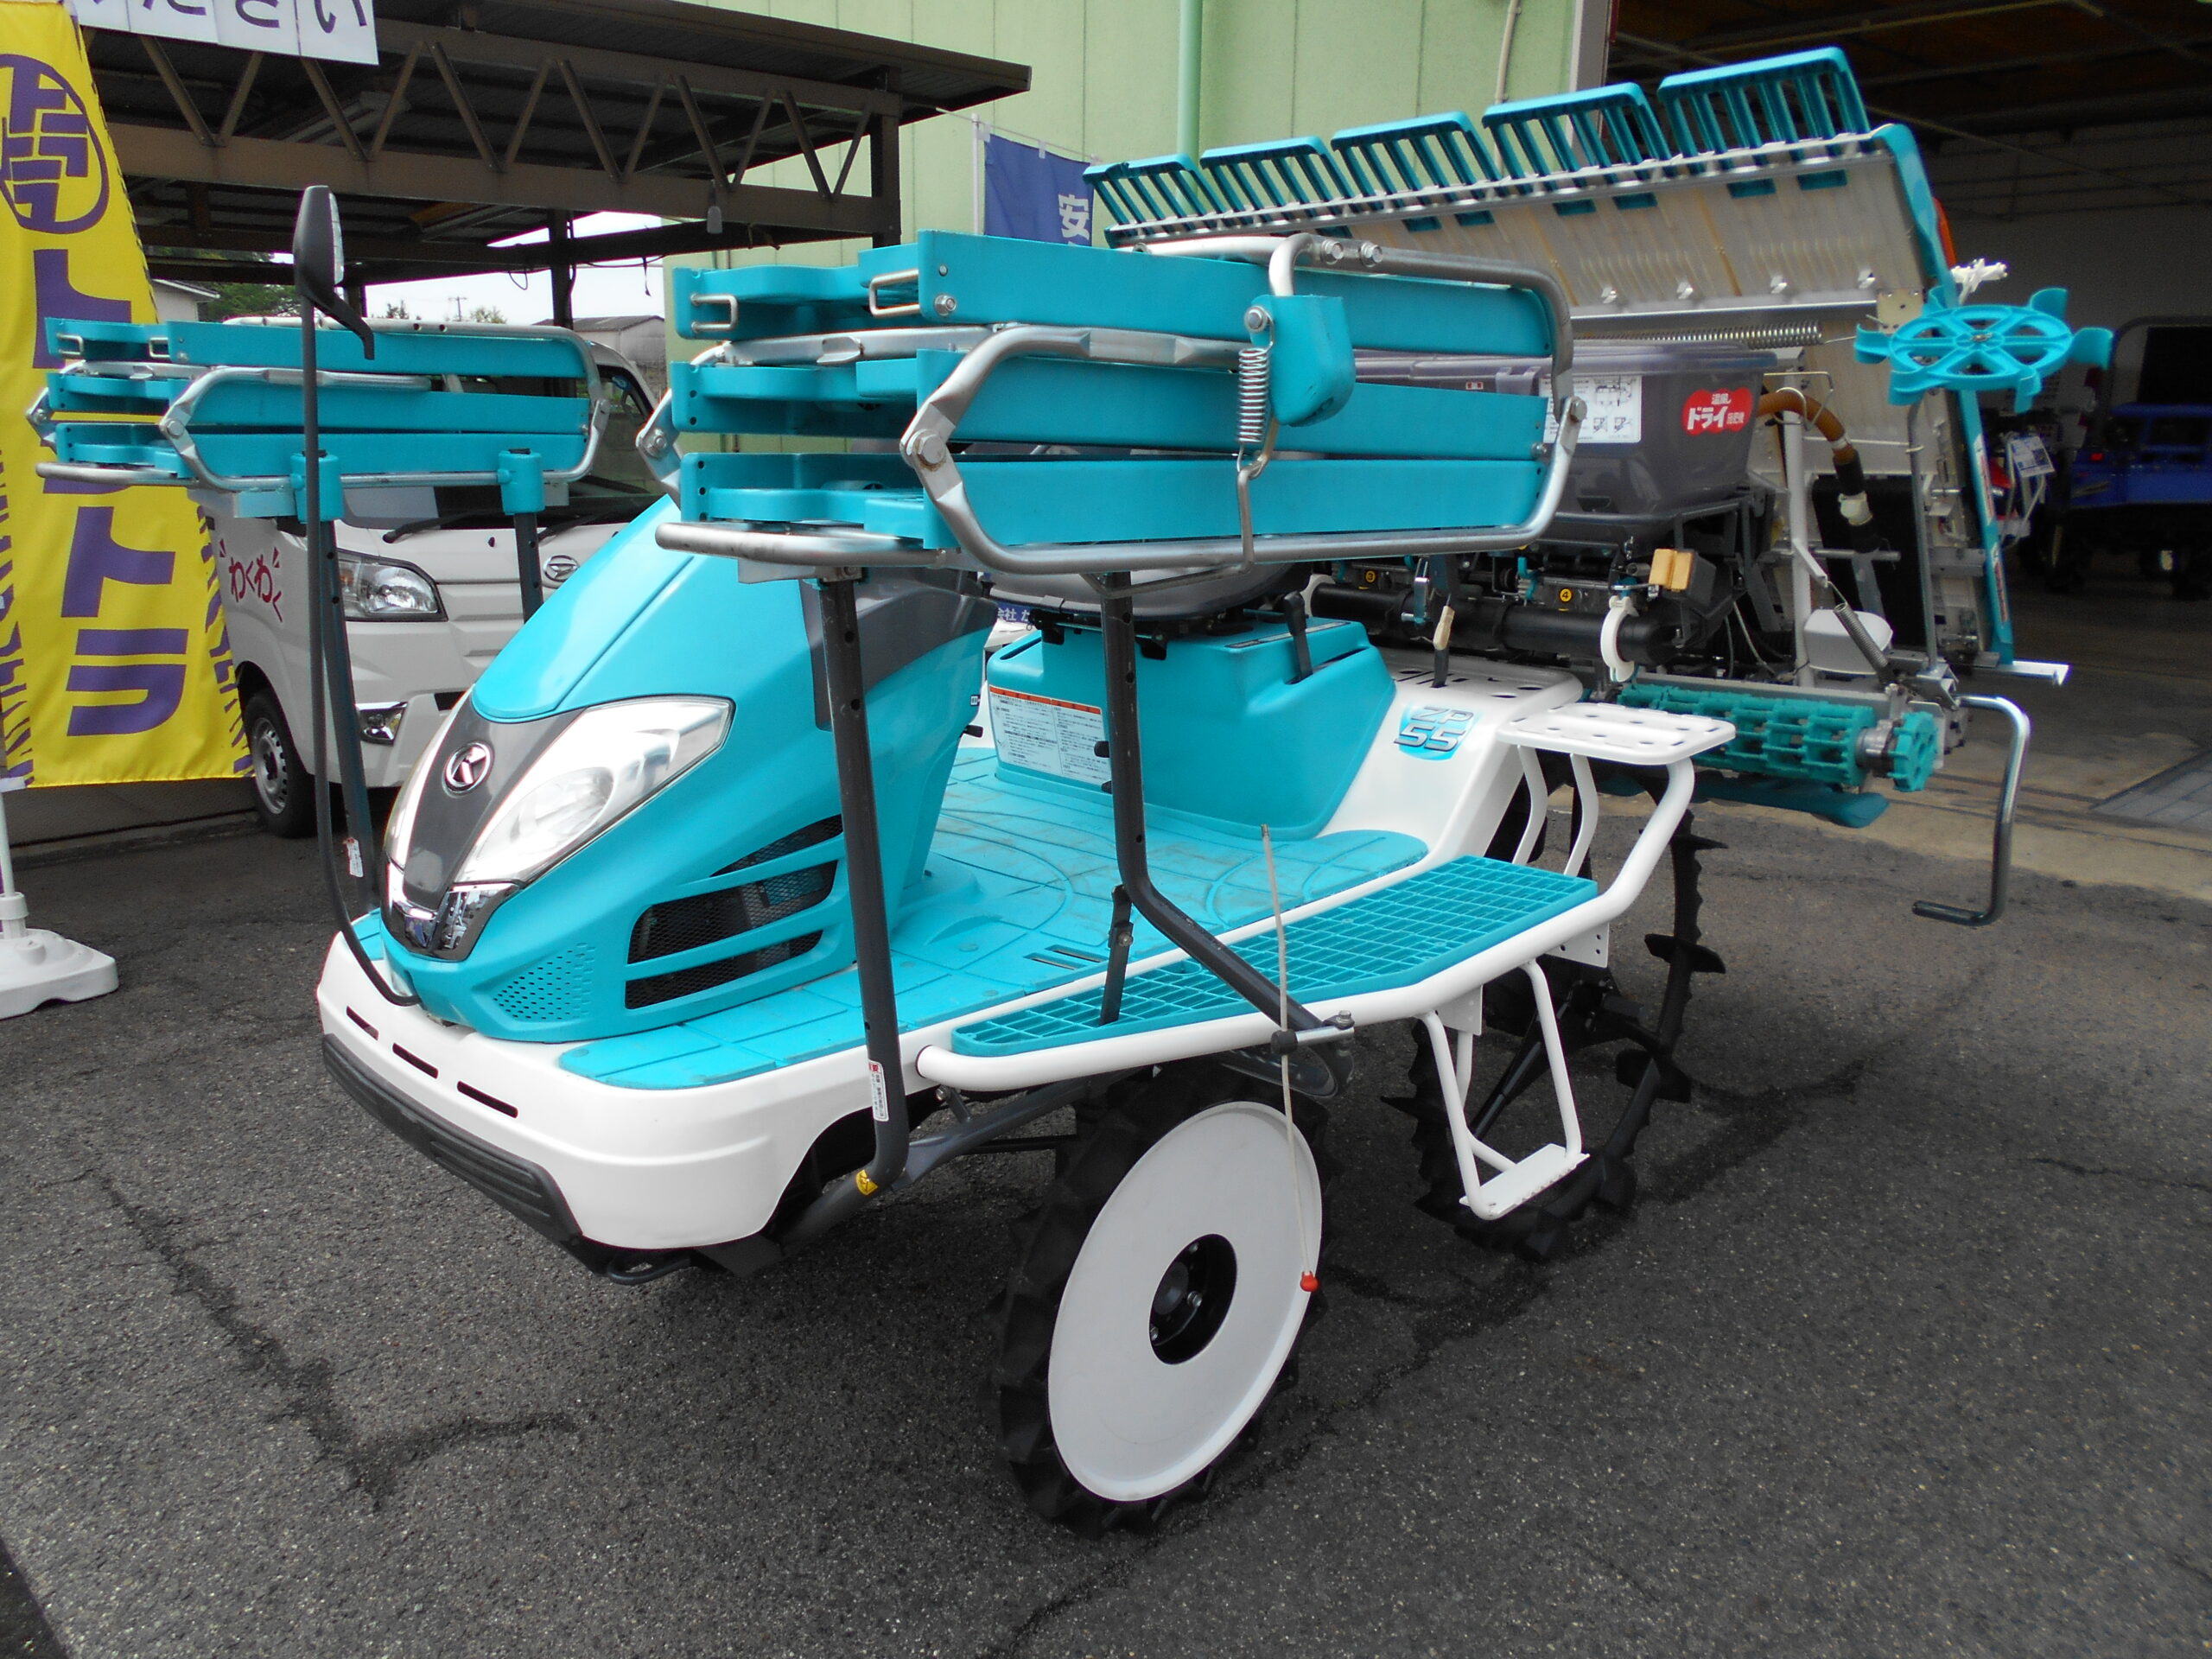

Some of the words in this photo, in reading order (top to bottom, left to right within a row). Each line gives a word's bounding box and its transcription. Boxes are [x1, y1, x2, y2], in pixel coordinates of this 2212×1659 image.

[1058, 194, 1090, 246] 安
[1688, 406, 1728, 430] ドライ
[1411, 706, 1474, 724] ZP
[1393, 724, 1466, 753] 55
